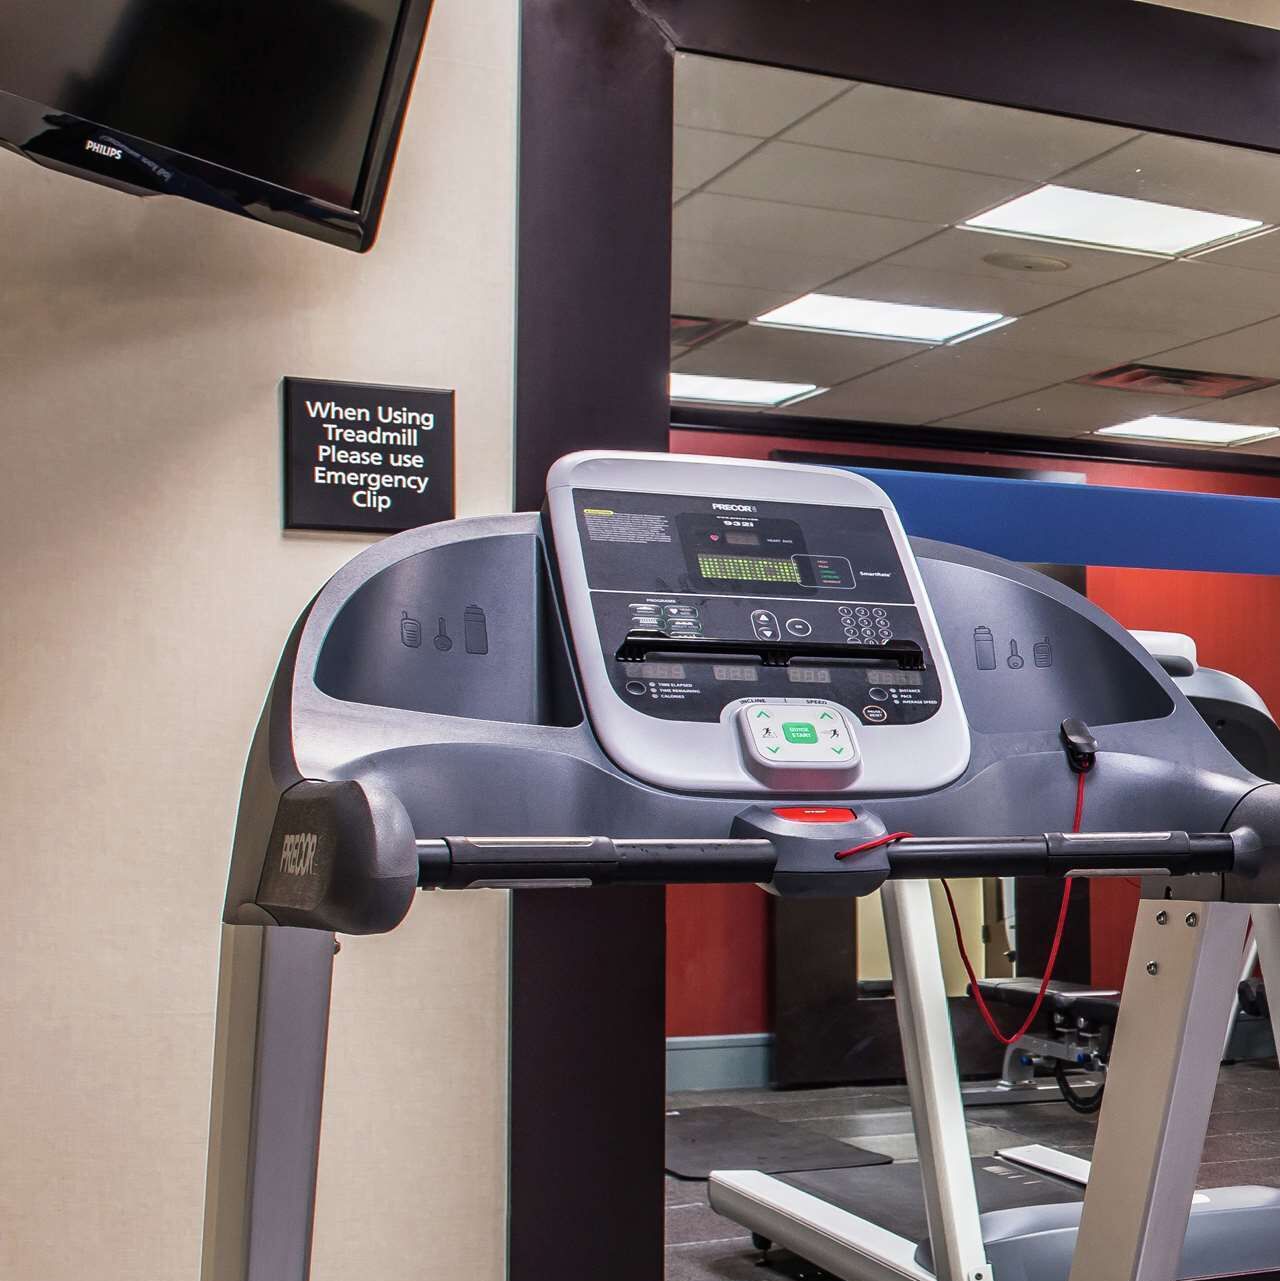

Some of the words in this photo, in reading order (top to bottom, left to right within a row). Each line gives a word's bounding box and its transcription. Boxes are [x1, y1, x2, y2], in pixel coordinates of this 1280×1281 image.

[84, 140, 123, 160] PHILIPS
[305, 401, 370, 422] When
[377, 406, 435, 430] Using
[322, 423, 418, 446] Treadmill
[318, 445, 383, 465] Please
[389, 453, 425, 468] use
[313, 466, 429, 494] Emergency
[352, 490, 392, 512] Clip
[712, 503, 752, 512] PRECOR
[279, 832, 318, 877] PRECOR
